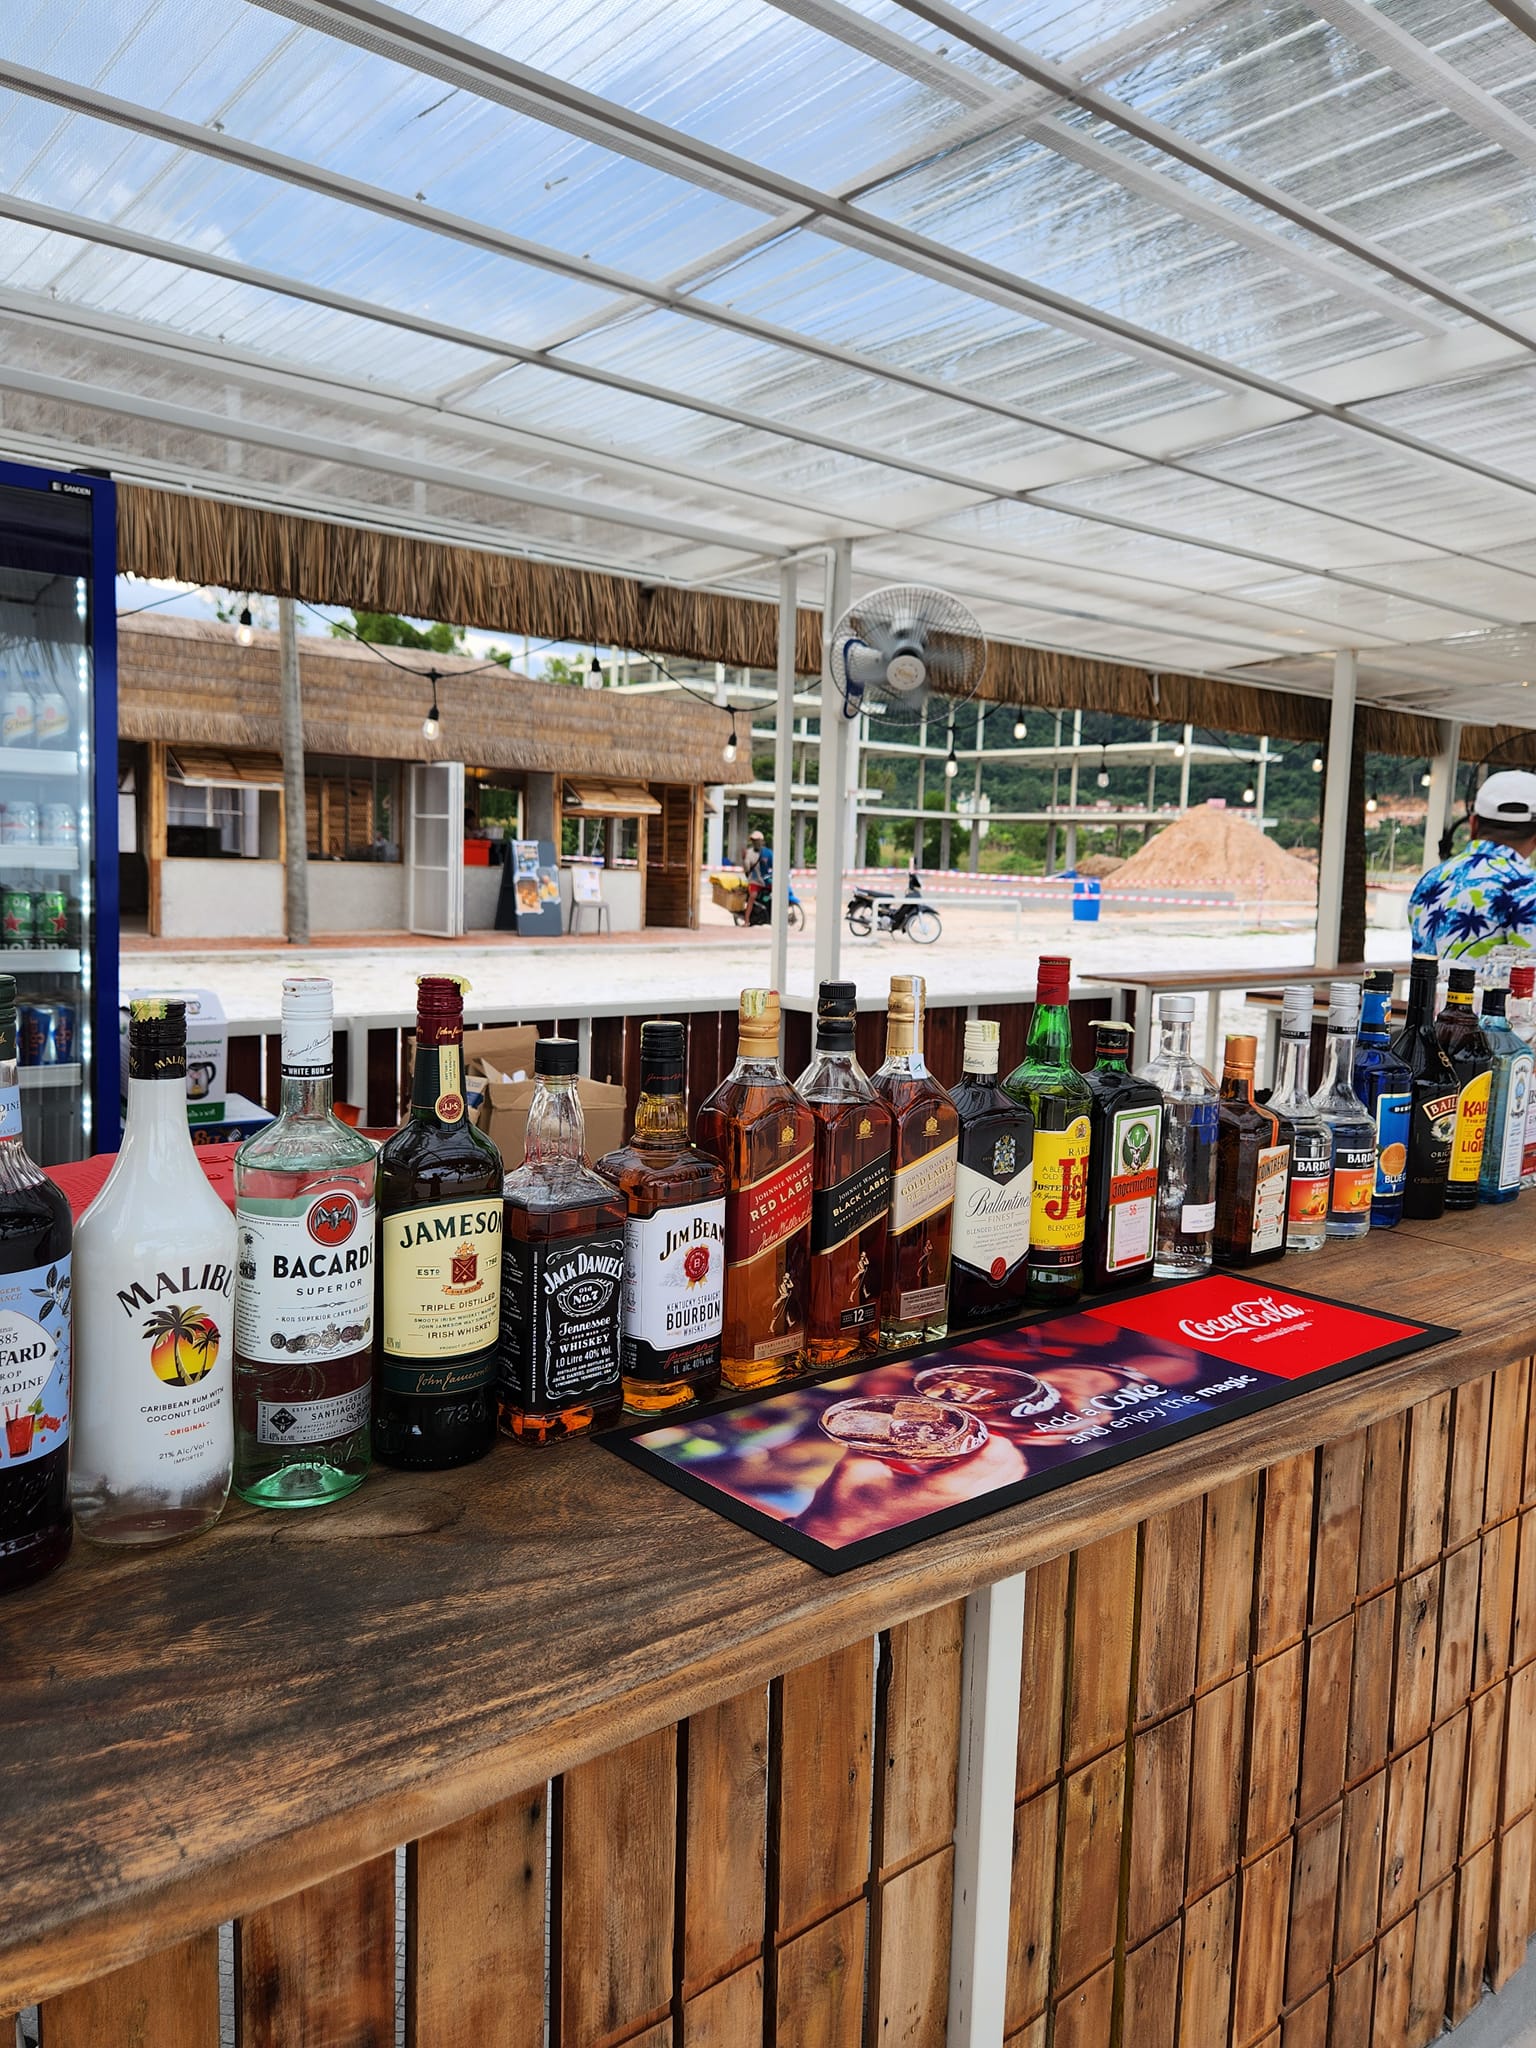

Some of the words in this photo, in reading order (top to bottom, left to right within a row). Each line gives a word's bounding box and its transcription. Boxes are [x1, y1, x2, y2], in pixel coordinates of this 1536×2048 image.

[288, 1067, 310, 1075] WHITE
[311, 1067, 324, 1075] RUM
[755, 1181, 785, 1205] JOHNNIE
[785, 1162, 812, 1183] WALKER
[832, 1194, 862, 1217] BLACK
[863, 1175, 890, 1196] LABEL
[838, 1182, 862, 1203] JOHNNIE
[862, 1167, 886, 1184] WALKER
[901, 1176, 926, 1195] GOLD
[750, 1199, 777, 1221] RED
[780, 1173, 814, 1203] LABEL
[988, 1211, 1015, 1223] FINEST
[660, 1226, 690, 1260] JIM
[296, 1278, 363, 1296] SUPERIOR
[543, 1261, 577, 1294] JACK
[116, 1264, 234, 1318] MALIBU
[420, 1303, 455, 1312] TRIPLE
[459, 1292, 495, 1309] DISTILLED
[558, 1316, 611, 1336] Tennessee
[667, 1301, 720, 1331] BOURBON
[853, 1309, 864, 1322] 12
[427, 1331, 455, 1339] IRISH
[457, 1320, 492, 1336] WHISKEY
[683, 1324, 707, 1336] WHISKEY
[560, 1333, 610, 1353] WHISKEY
[140, 1399, 190, 1413] CARIBBEAN
[192, 1394, 208, 1404] RUM
[209, 1386, 224, 1398] WITH
[147, 1409, 191, 1423] COCONUT
[193, 1398, 221, 1414] LIQUEUR
[311, 1403, 356, 1420] SANTIAGO
[1034, 1412, 1083, 1433] Add
[1080, 1407, 1096, 1417] a
[1089, 1383, 1168, 1411] Coke
[1065, 1425, 1112, 1446] and
[1110, 1406, 1167, 1430] enjoy
[1160, 1395, 1200, 1410] the
[1196, 1374, 1258, 1399] magic
